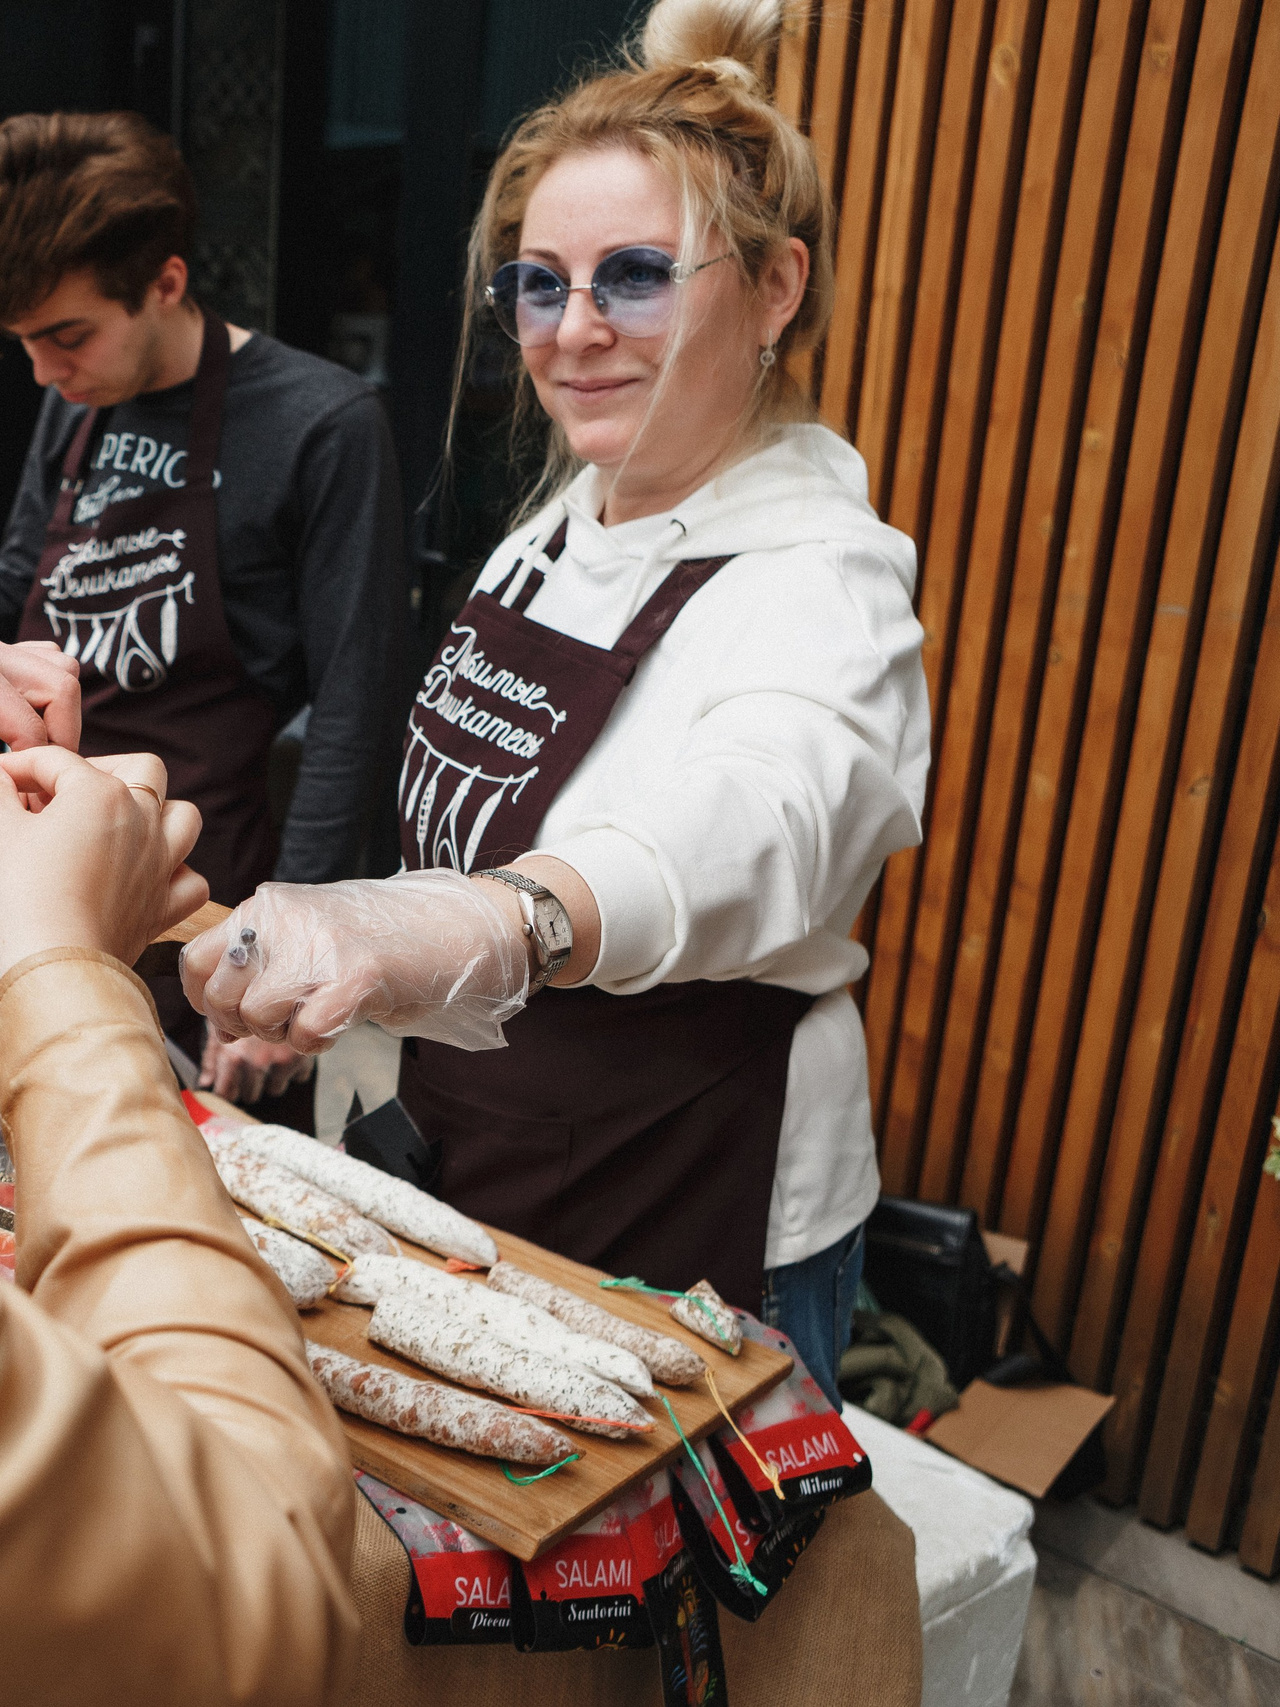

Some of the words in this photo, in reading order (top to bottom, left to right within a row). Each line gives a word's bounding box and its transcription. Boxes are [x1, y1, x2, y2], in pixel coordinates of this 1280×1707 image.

[765, 1430, 840, 1475] SALAMI
[799, 1475, 843, 1496] Milano
[654, 1517, 682, 1560] SALA
[555, 1558, 632, 1589] SALAMI
[454, 1576, 511, 1606] SALA
[567, 1599, 632, 1622] Santorini
